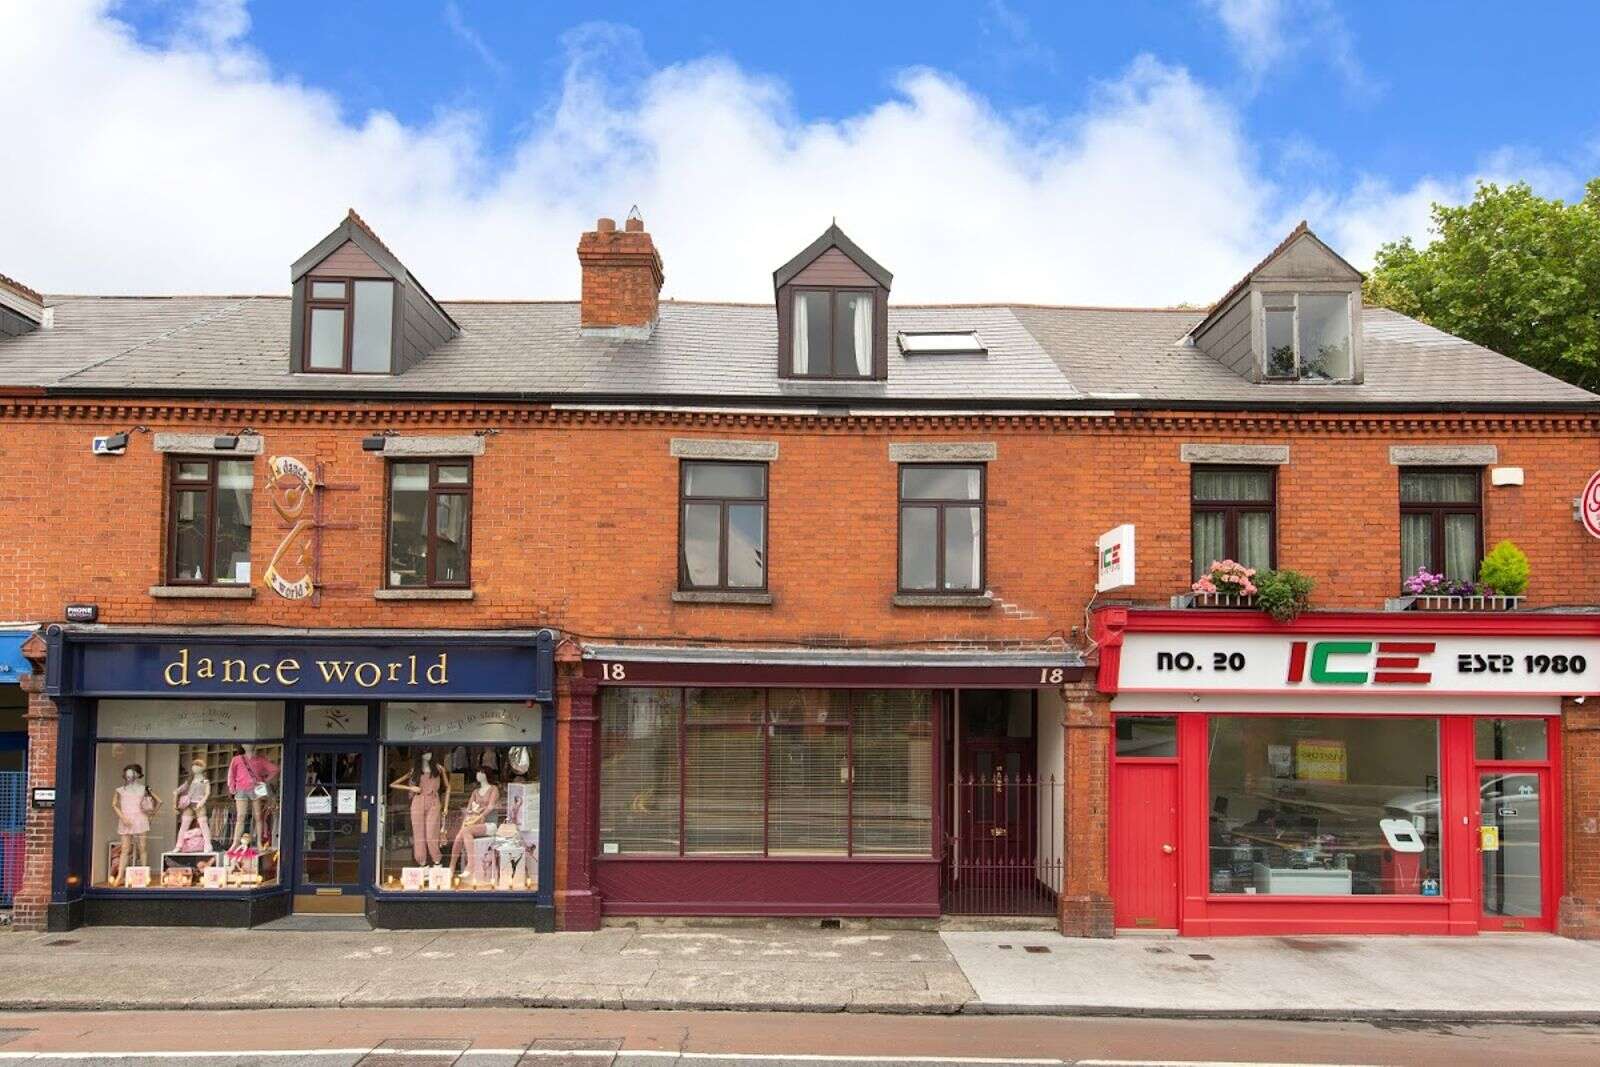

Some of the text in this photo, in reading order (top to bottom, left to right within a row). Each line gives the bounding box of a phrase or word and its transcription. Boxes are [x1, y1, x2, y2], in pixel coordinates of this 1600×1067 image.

[283, 459, 307, 481] dance
[1100, 544, 1120, 569] ICE
[278, 582, 304, 598] world
[164, 649, 449, 688] dance world
[601, 663, 626, 680] 18
[1213, 652, 1246, 671] 20
[1287, 641, 1436, 684] ICE
[1458, 654, 1514, 673] ESTD
[1524, 654, 1587, 674] 1980
[1040, 668, 1064, 684] 18
